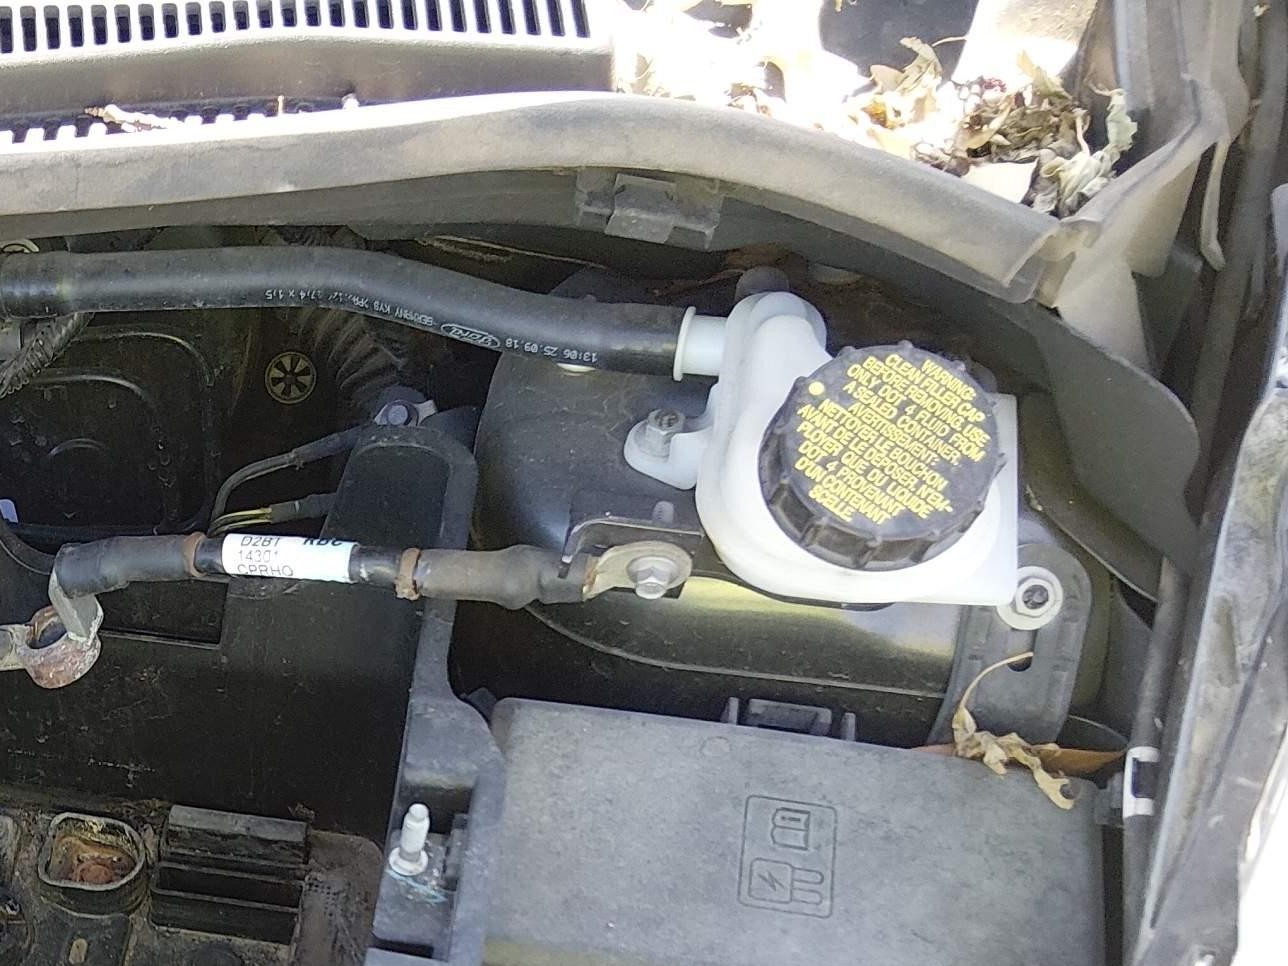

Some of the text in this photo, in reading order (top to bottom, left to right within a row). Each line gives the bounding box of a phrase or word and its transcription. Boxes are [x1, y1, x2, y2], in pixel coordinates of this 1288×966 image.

[445, 323, 497, 347] Ford
[505, 338, 558, 357] 25.09.18
[564, 349, 598, 363] 13:06
[843, 381, 858, 394] A
[853, 386, 898, 419] SEALED
[863, 356, 910, 392] BEFORE
[962, 424, 991, 447] USE
[885, 354, 985, 422] CLEAN FILLER CAP
[921, 360, 976, 400] WARNING:
[797, 404, 840, 432] AVANT
[833, 427, 854, 444] DE
[849, 438, 870, 454] LE
[847, 364, 986, 462] ONLY DOT 4 FLUID FROM
[848, 402, 939, 465] AVERTISSEMENT:
[797, 421, 934, 519] PLOYER QUE DU LIQUIDE
[818, 399, 949, 491] NETTOYER LE BOUCHON
[798, 441, 905, 516] DOT 4 PROVENANT
[822, 475, 891, 524] CONTENANT
